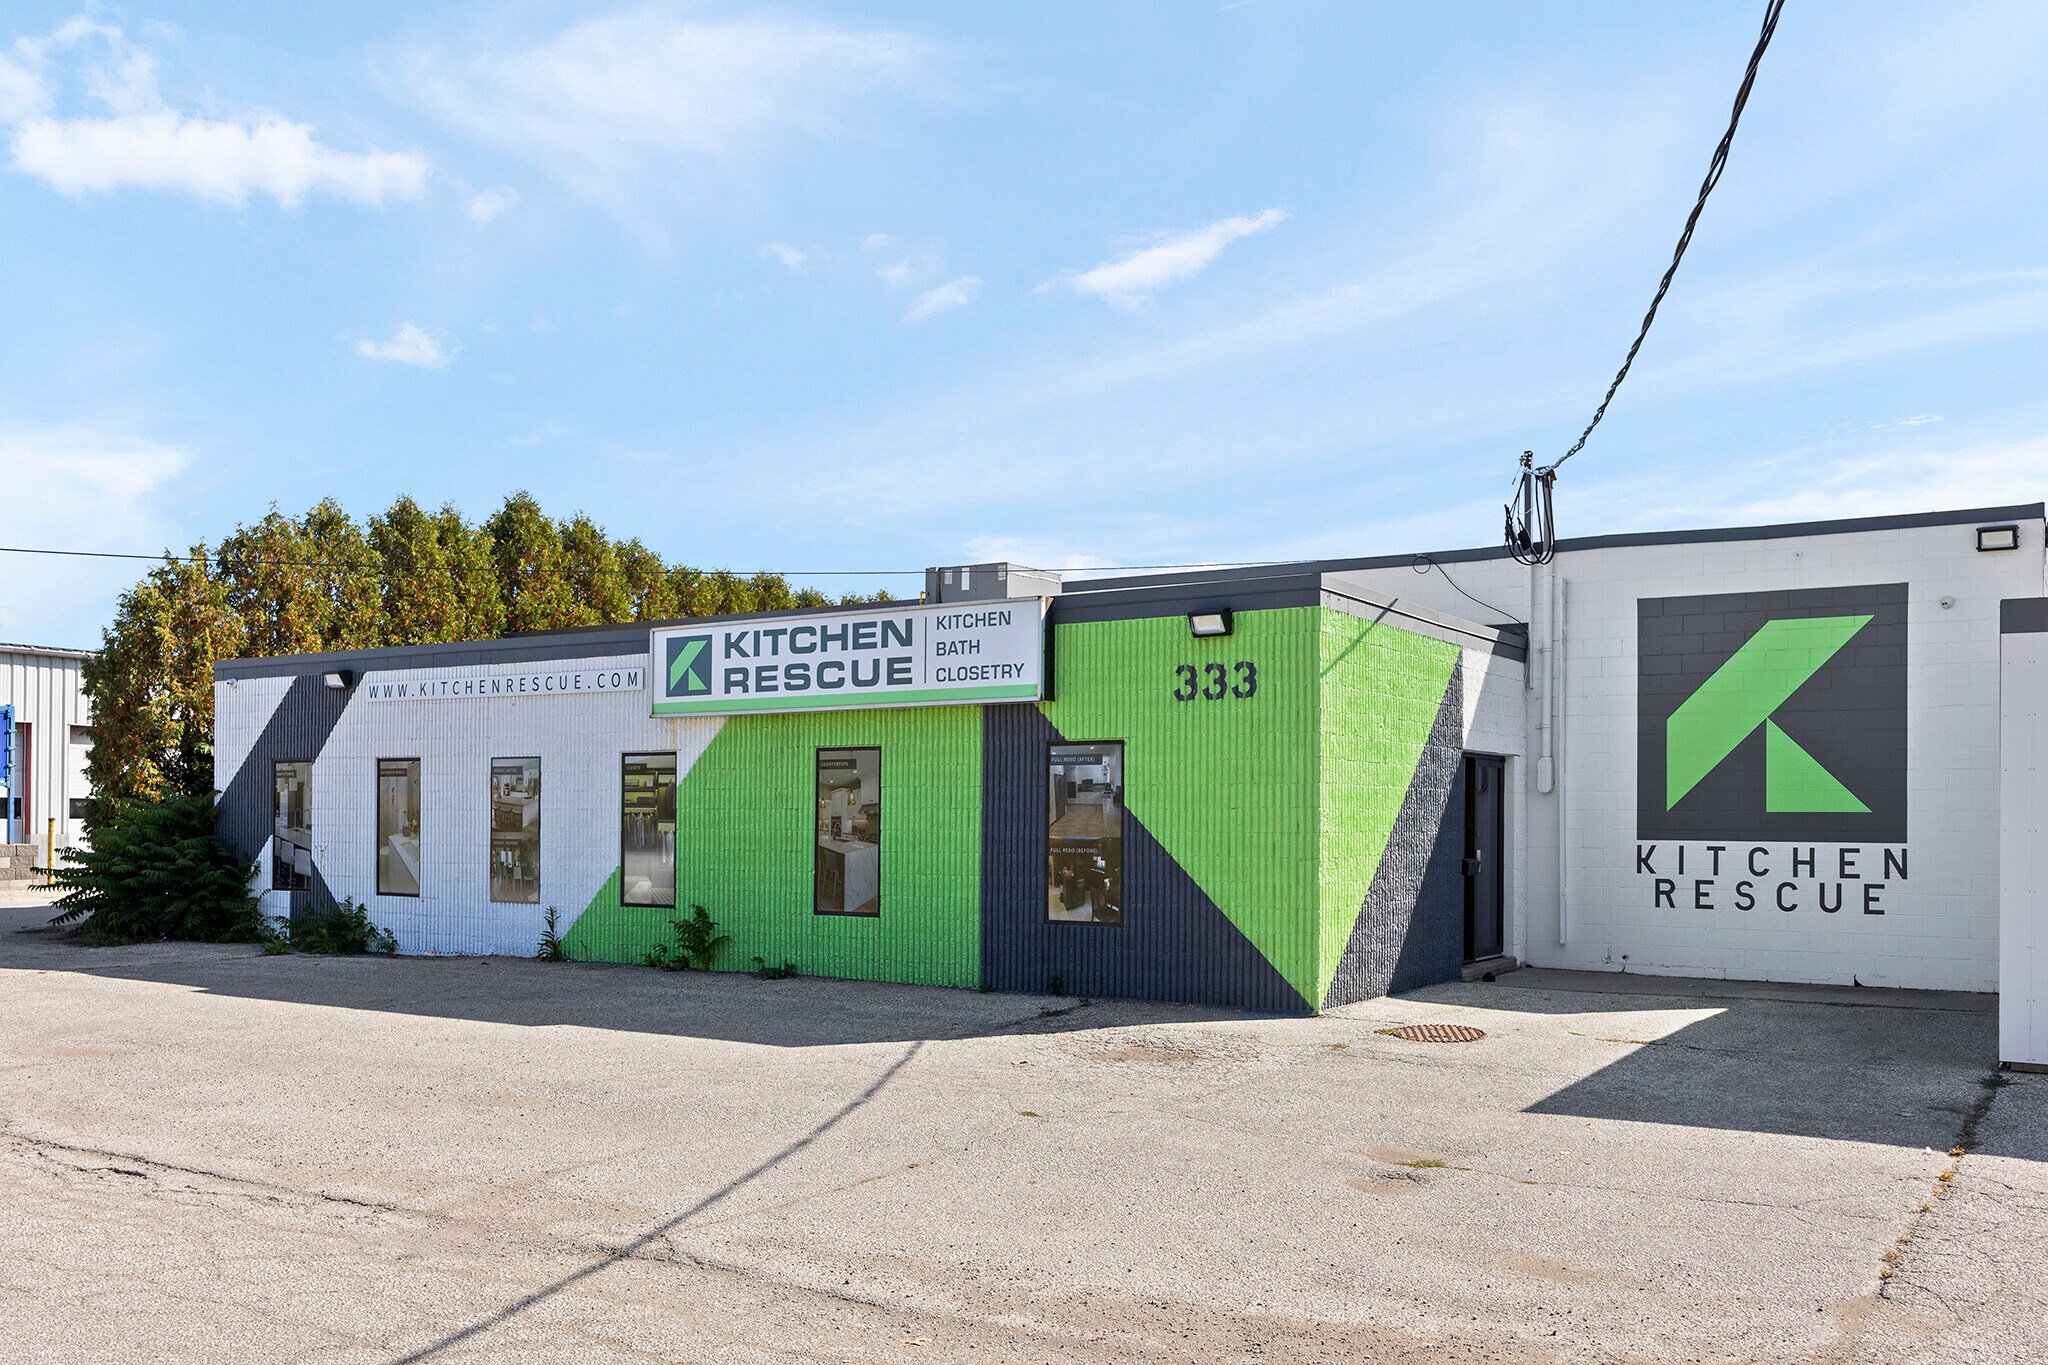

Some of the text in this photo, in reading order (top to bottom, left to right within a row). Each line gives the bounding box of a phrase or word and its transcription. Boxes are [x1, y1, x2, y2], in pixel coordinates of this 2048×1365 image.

[724, 618, 913, 659] KITCHEN
[936, 610, 1012, 631] KITCHEN
[936, 639, 981, 657] BATH
[369, 671, 639, 699] WWW.KITCHENRESCUE.COM
[724, 656, 913, 695] RESCUE
[936, 662, 1026, 684] CLOSETRY
[1173, 661, 1258, 702] 333
[1636, 844, 1909, 880] KITCHEN
[1654, 878, 1886, 915] RESCUE
